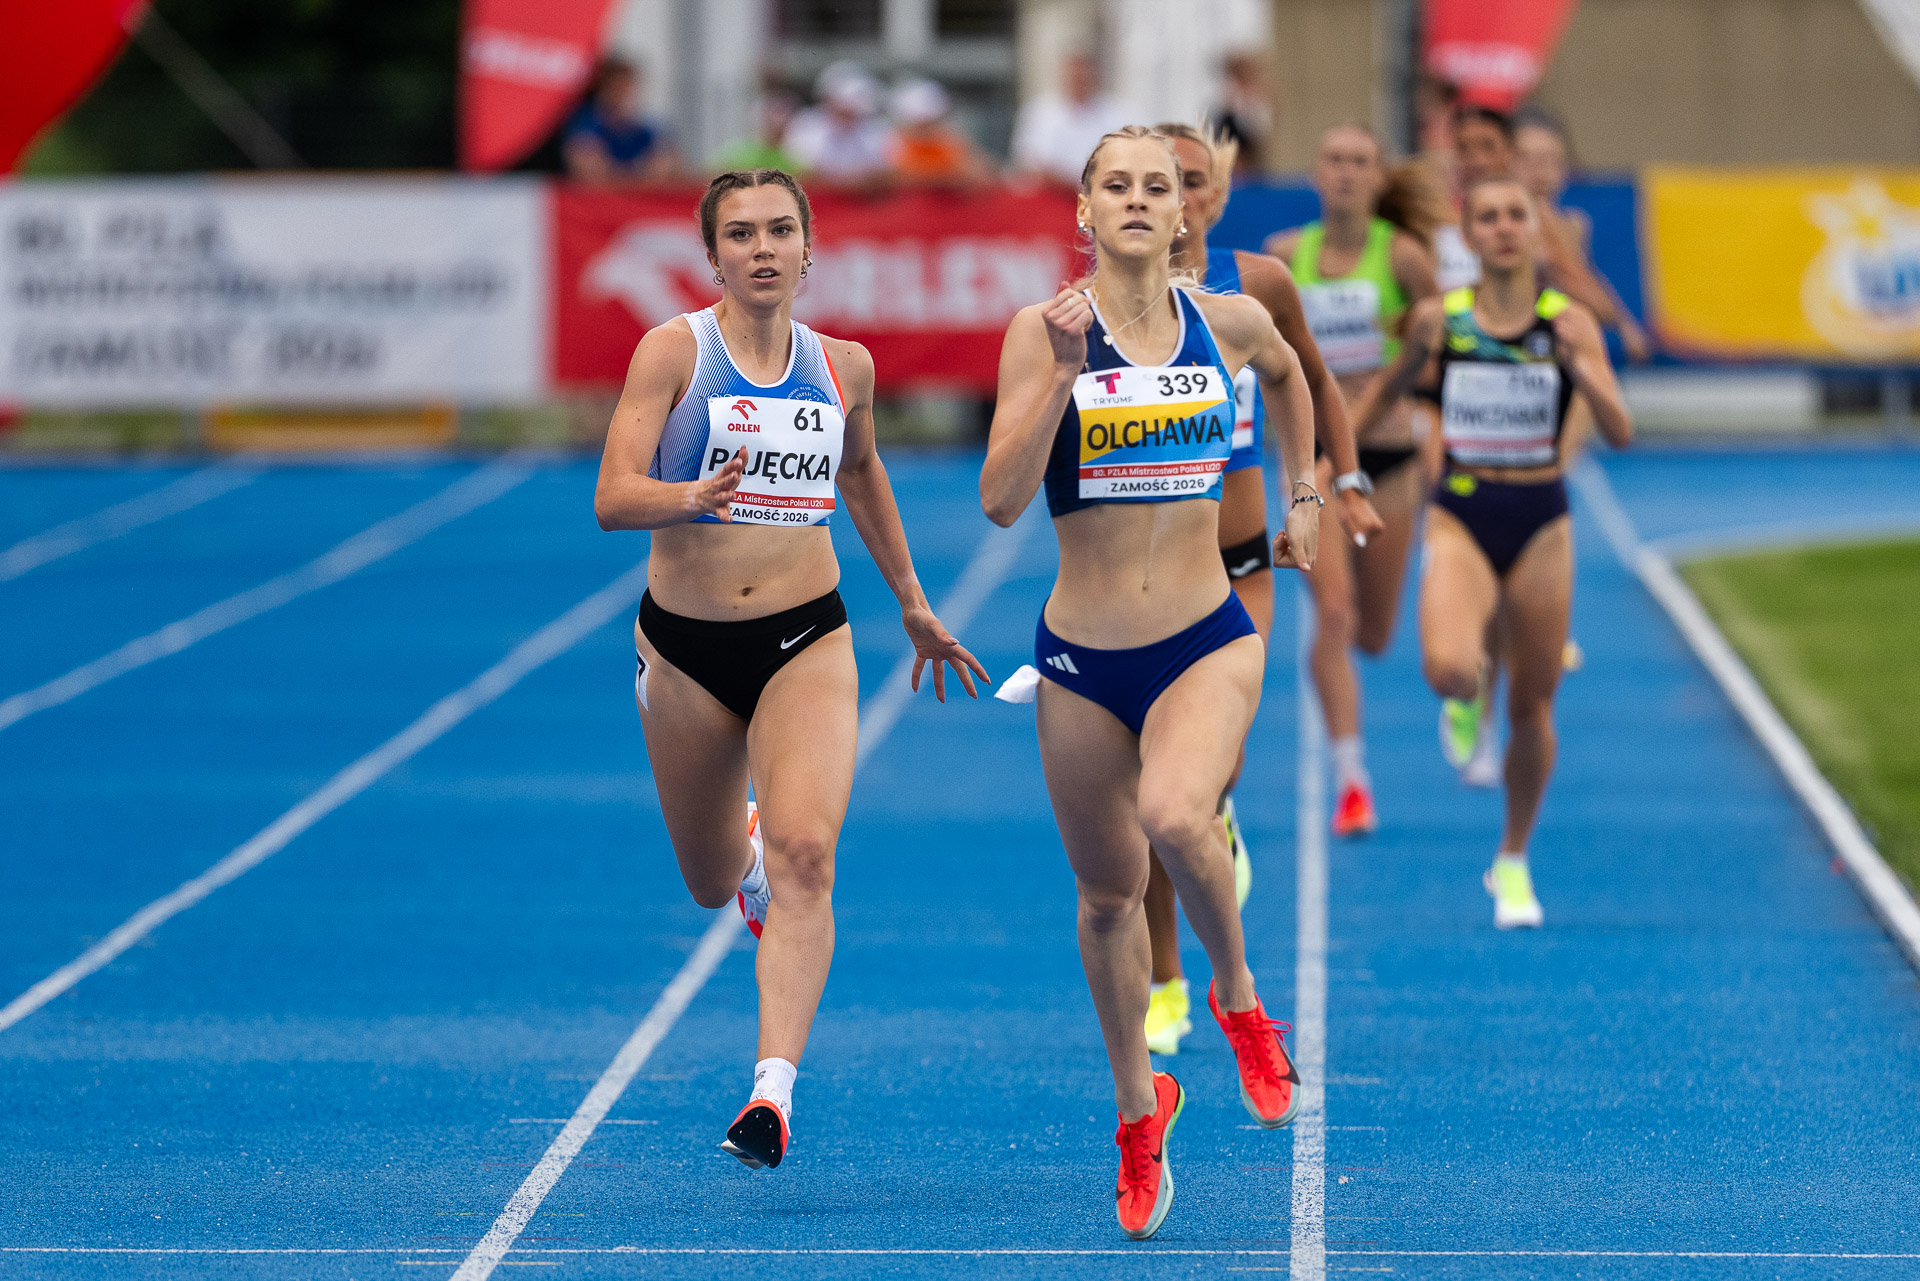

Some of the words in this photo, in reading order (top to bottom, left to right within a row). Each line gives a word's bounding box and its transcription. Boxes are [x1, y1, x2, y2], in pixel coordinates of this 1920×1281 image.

[1157, 373, 1208, 397] 339
[1092, 396, 1134, 406] TRYUMF
[793, 407, 824, 432] 61
[727, 423, 760, 433] ORLEN
[1087, 415, 1225, 451] OLCHAWA
[1093, 468, 1106, 477] 80.
[1107, 467, 1128, 477] PZLA
[1129, 465, 1179, 476] Mistrzostwa
[1180, 463, 1204, 474] Polski
[1205, 462, 1222, 472] U20
[1110, 479, 1170, 493] ZAMOŚĆ
[1173, 478, 1205, 491] 2026
[744, 495, 789, 507] Mistrzostwa
[789, 499, 809, 507] Polski
[810, 499, 825, 508] U20
[782, 512, 809, 522] 2026
